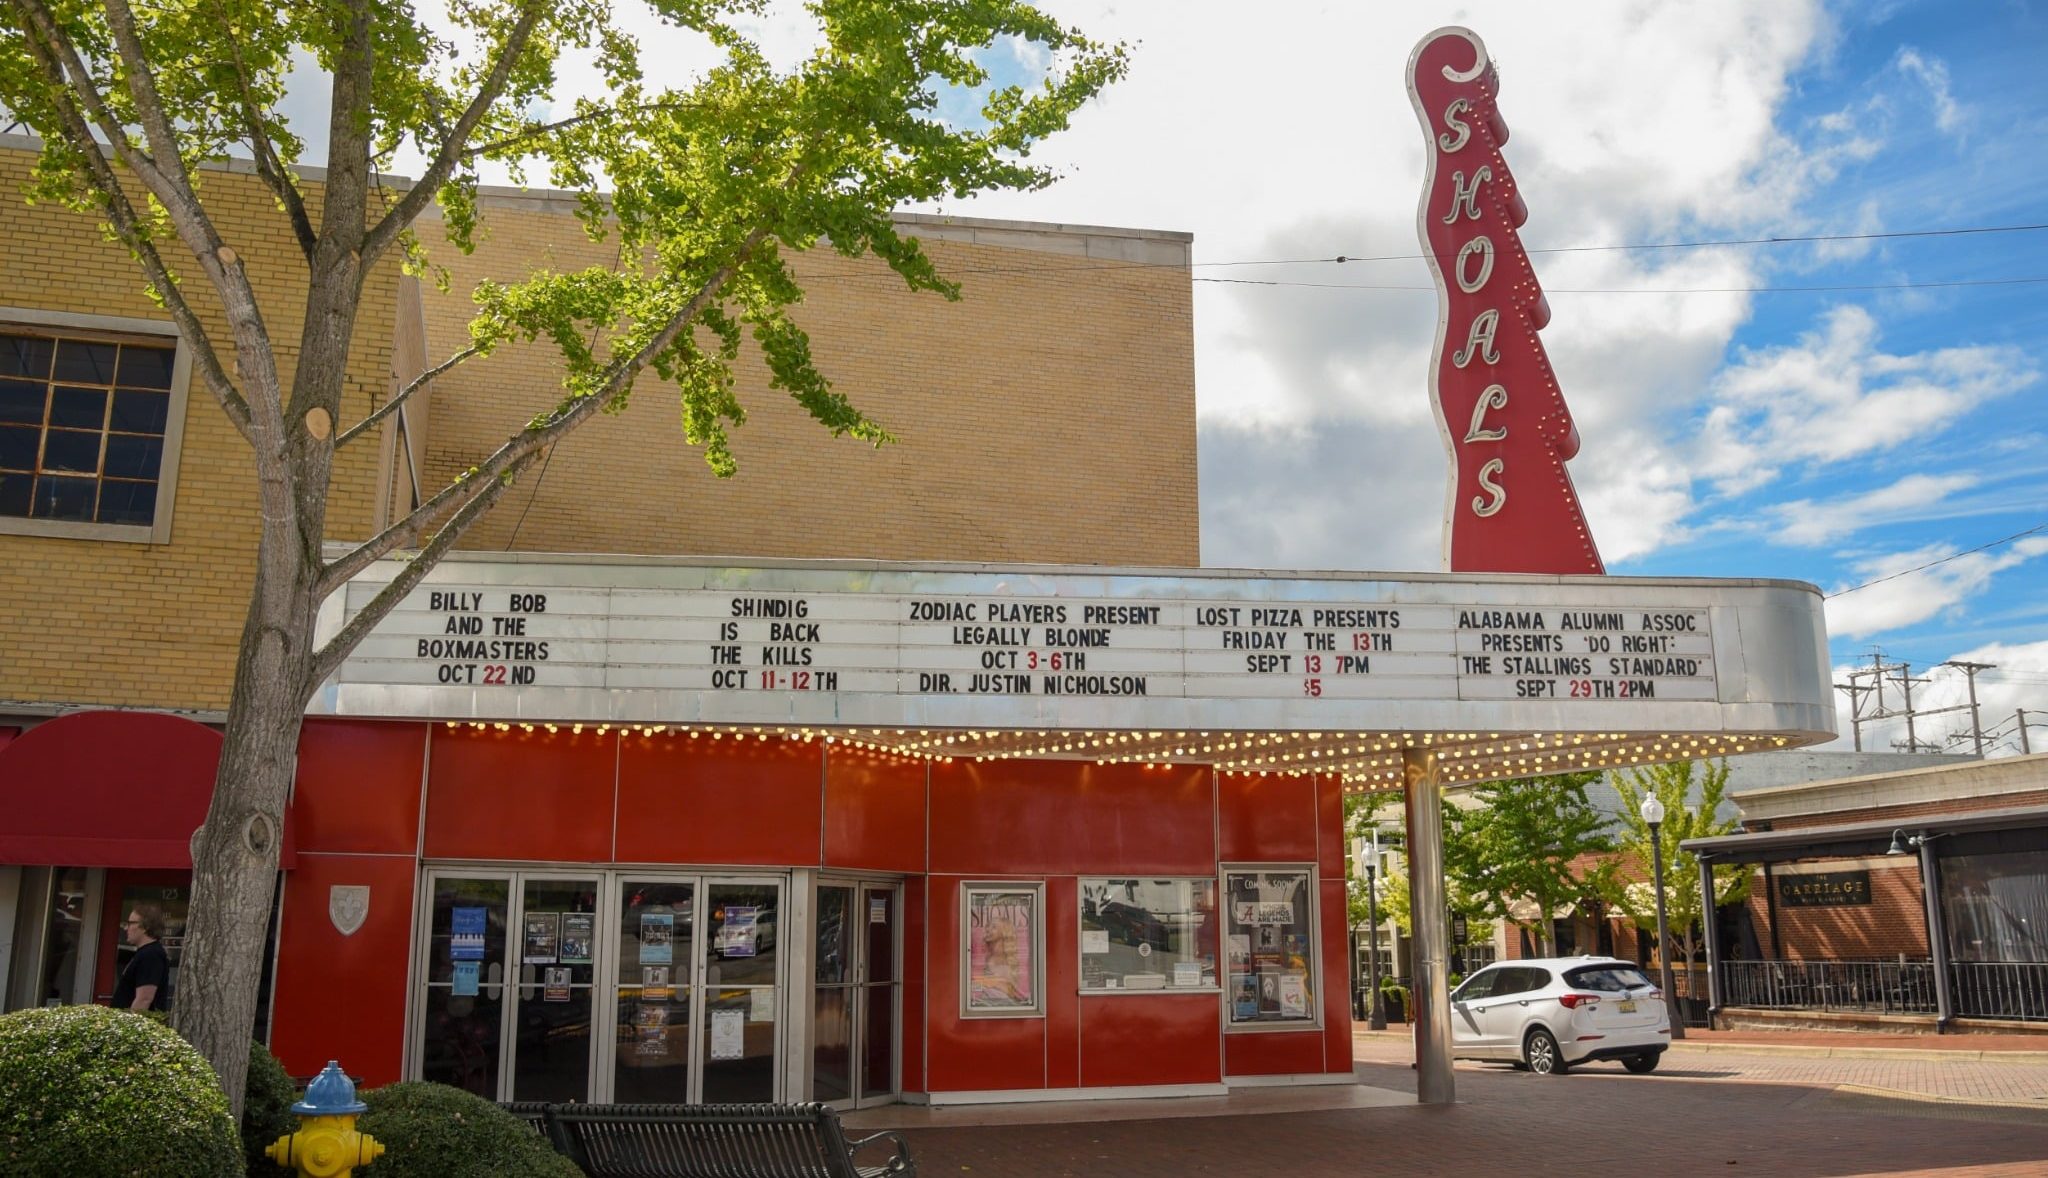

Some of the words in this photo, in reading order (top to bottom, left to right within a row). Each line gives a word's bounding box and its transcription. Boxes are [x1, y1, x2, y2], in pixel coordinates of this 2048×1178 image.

[1439, 98, 1507, 517] SHOALS
[429, 591, 483, 612] BILLY
[509, 593, 547, 613] BOB
[731, 597, 808, 619] SHINDIG
[909, 601, 977, 622] ZODIAC
[988, 603, 1067, 624] PLAYERS
[1084, 605, 1161, 625] PRESENT
[444, 615, 483, 636] AND
[492, 616, 527, 638] THE
[1196, 607, 1241, 627] LOST
[1251, 608, 1304, 628] PIZZA
[1313, 609, 1400, 629] PRESENTS
[1458, 610, 1545, 630] ALABAMA
[1560, 612, 1625, 631] ALUMNI
[1642, 613, 1696, 632] ASSOC
[720, 621, 738, 642] IS
[770, 622, 820, 643] BACK
[953, 626, 1031, 646] LEGALLY
[1045, 627, 1111, 648] BLONDE
[1222, 630, 1287, 650] FRIDAY
[1303, 631, 1336, 651] THE
[1352, 632, 1392, 652] 13TH
[1481, 633, 1564, 653] PRESENTS
[417, 638, 549, 661] BOXMASTERS
[710, 645, 742, 665] THE
[762, 646, 812, 666] KILLS
[981, 650, 1018, 670] OCT
[438, 663, 478, 685] OCT
[1246, 654, 1292, 674] SEPT
[1304, 654, 1322, 674] 13
[1335, 655, 1370, 675] 7PM
[1462, 655, 1492, 675] THE
[1502, 656, 1592, 676] STALLINGS
[711, 669, 748, 690] OCT
[919, 672, 958, 694] DIR.
[967, 673, 1032, 694] JUSTIN
[1043, 675, 1147, 696] NICHOLSON
[1303, 678, 1322, 698] $5
[1516, 678, 1557, 698] SEPT
[1569, 679, 1615, 699] 29TH
[1618, 679, 1655, 698] 2PM
[1783, 882, 1863, 896] CARRIAGE
